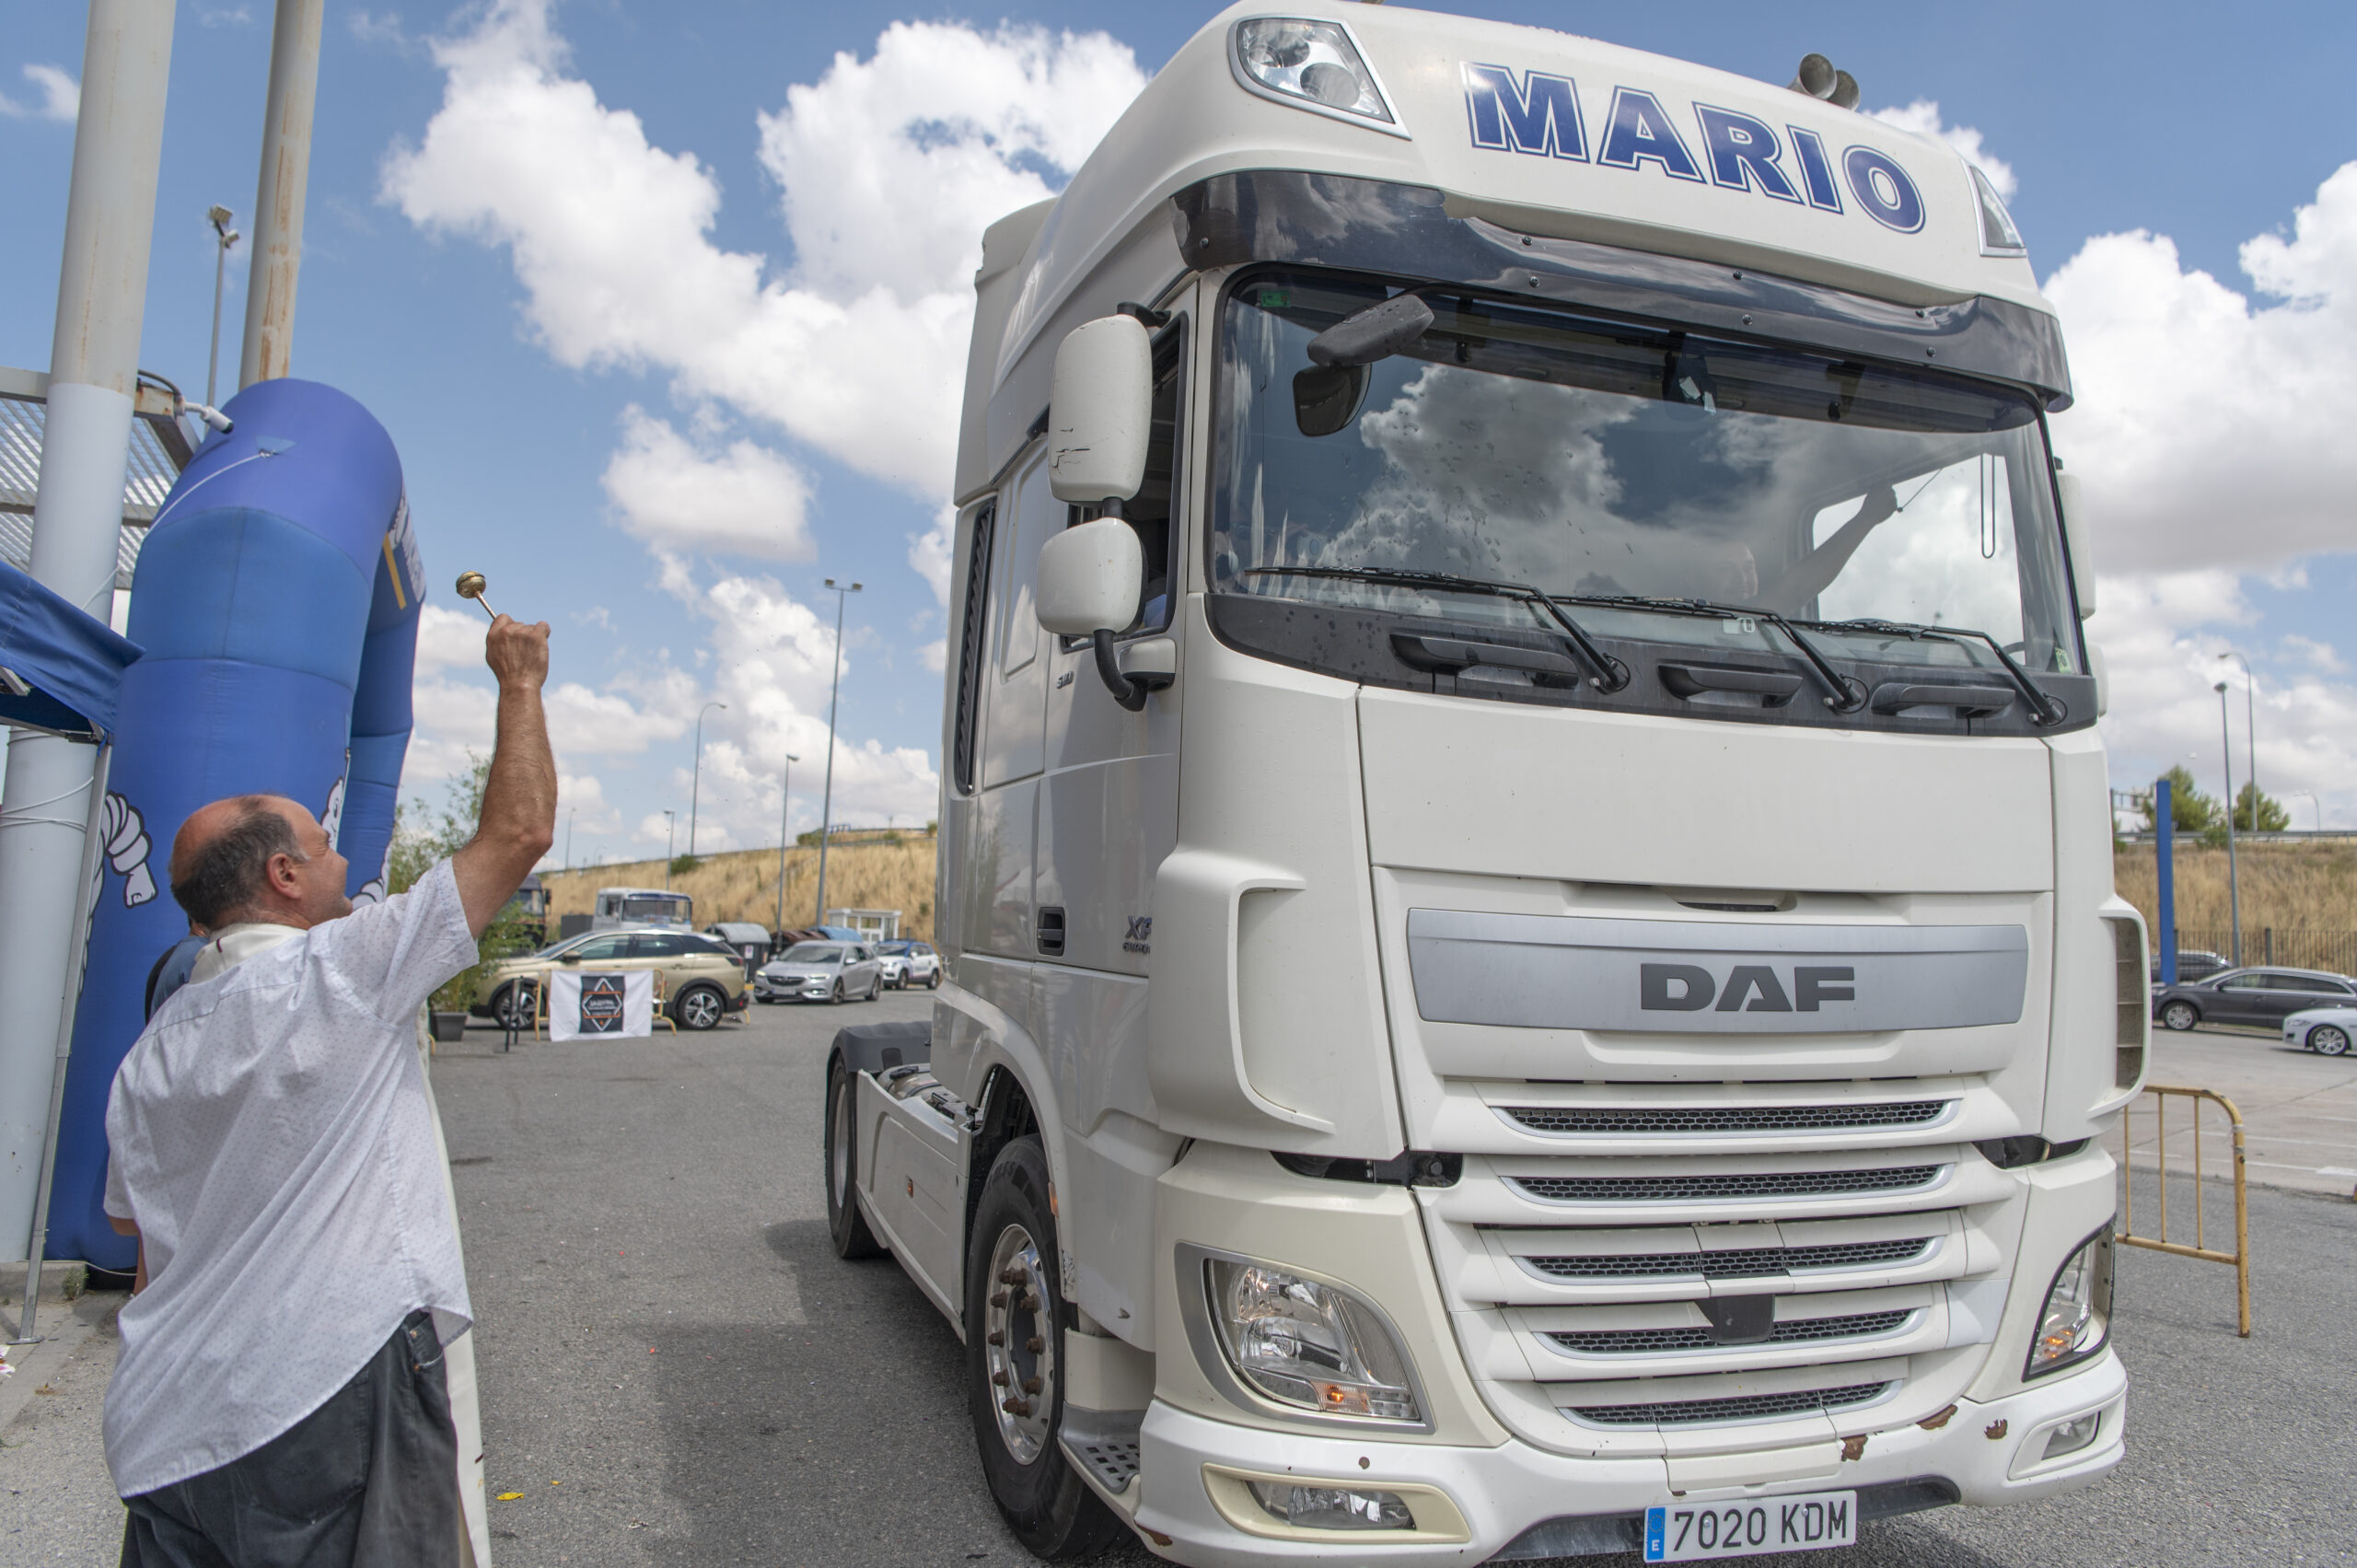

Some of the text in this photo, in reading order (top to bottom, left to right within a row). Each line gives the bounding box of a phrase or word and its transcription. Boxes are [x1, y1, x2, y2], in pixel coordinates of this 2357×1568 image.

[1459, 61, 1926, 235] MARIO
[1641, 963, 1855, 1012] DAF
[1652, 1539, 1661, 1551] E
[1673, 1506, 1767, 1552] 7020
[1781, 1500, 1847, 1544] KDM
